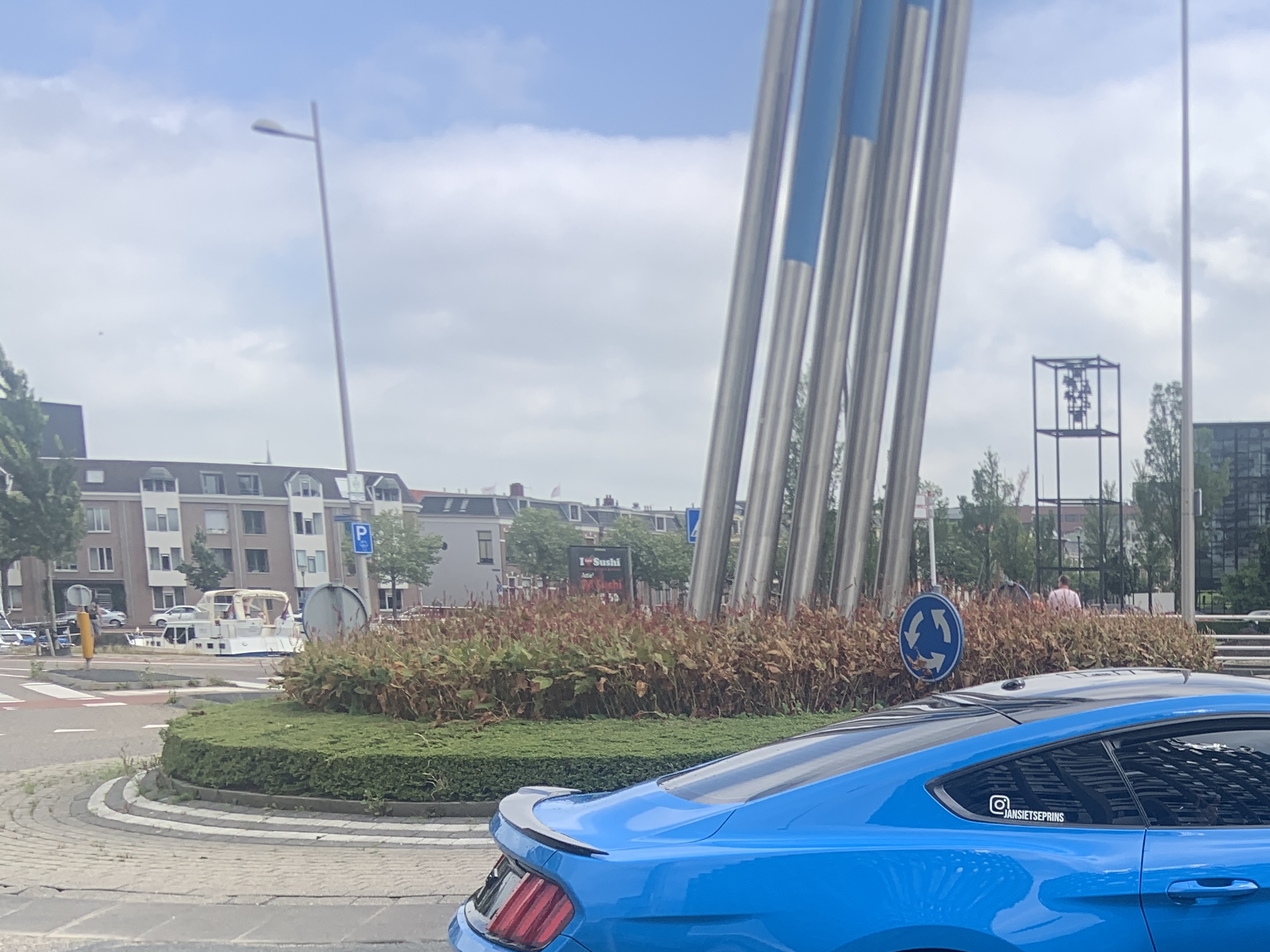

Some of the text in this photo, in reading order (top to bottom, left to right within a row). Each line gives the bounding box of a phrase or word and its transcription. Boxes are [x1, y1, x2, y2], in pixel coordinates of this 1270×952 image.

[356, 525, 367, 541] P
[593, 557, 620, 566] Sushi
[1004, 809, 1064, 822] JANSIETSEPRINS
